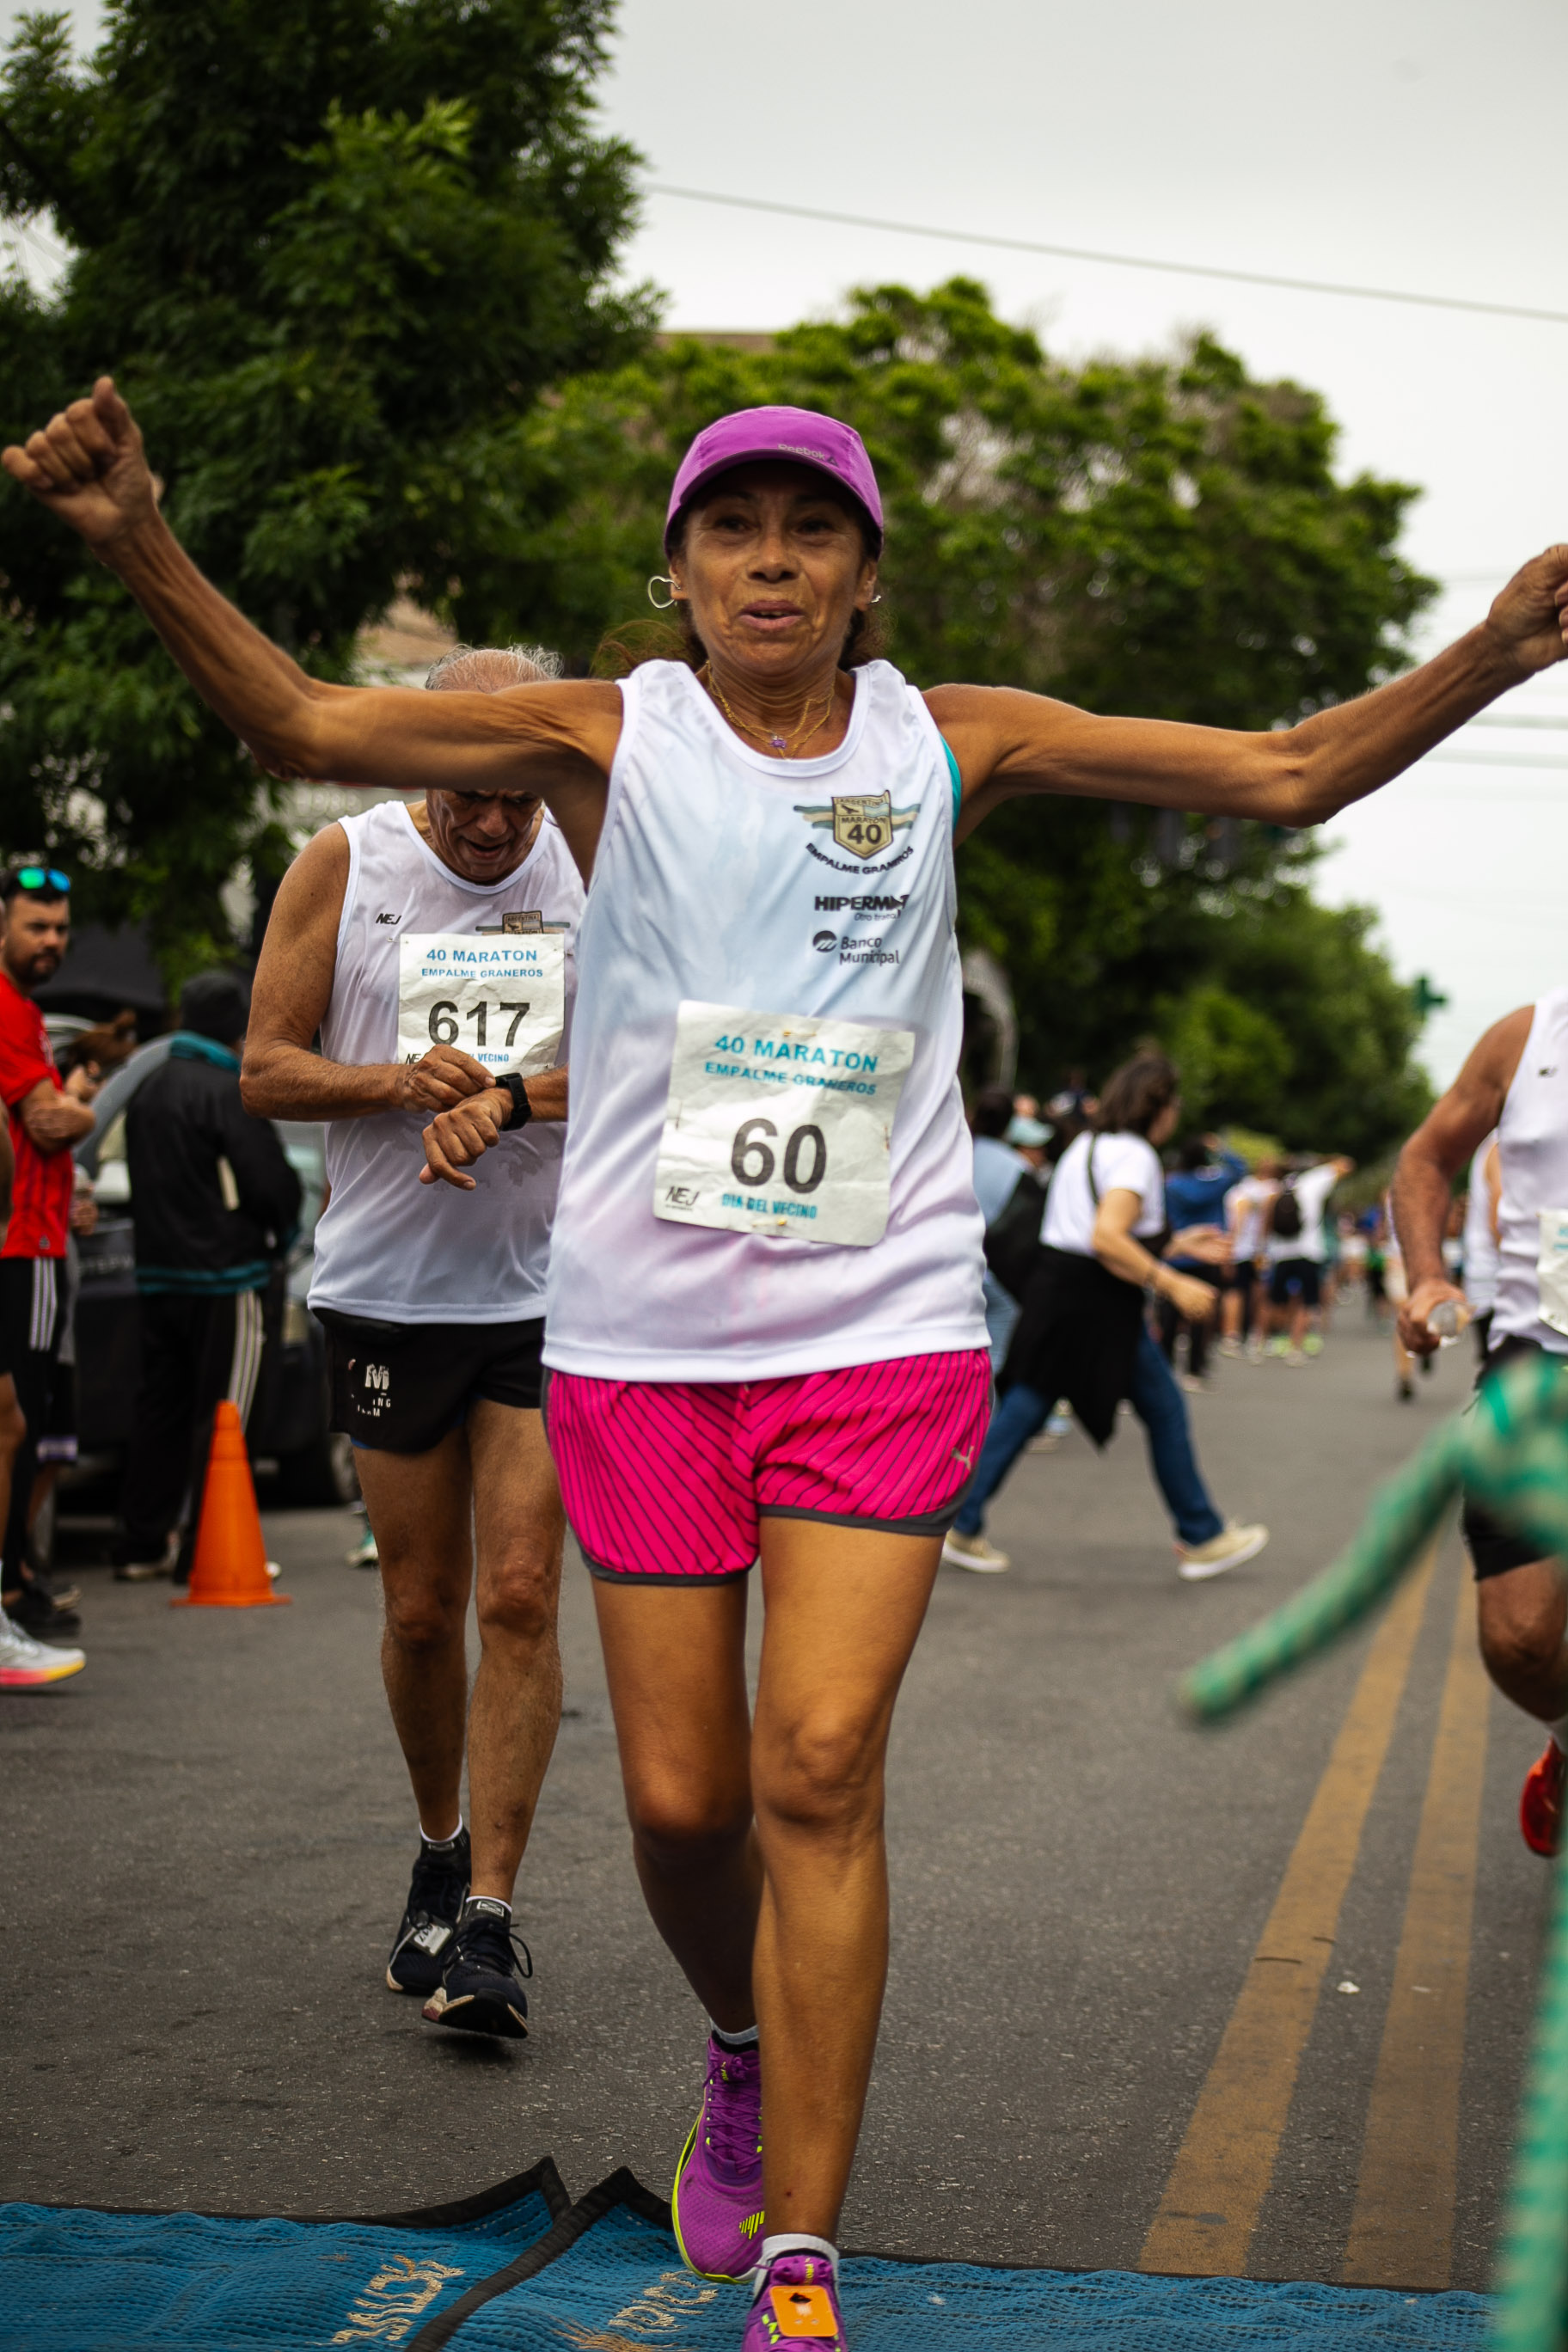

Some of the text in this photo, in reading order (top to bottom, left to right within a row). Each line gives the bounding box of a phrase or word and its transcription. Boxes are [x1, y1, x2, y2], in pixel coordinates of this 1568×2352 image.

[848, 824, 882, 845] 40
[805, 842, 860, 874] EMPALME
[375, 913, 402, 925] NEJ
[841, 936, 882, 950] Banco
[426, 948, 537, 963] 40 MARATON
[421, 968, 544, 978] EMPALME GRANEROS
[428, 1000, 530, 1047] 617
[405, 1053, 422, 1065] NE
[477, 1053, 510, 1063] VECINO
[714, 1035, 879, 1073] 40 MARATON
[705, 1061, 877, 1096] EMPALME GRANEROS
[731, 1118, 827, 1195] 60
[665, 1185, 701, 1206] NEJ
